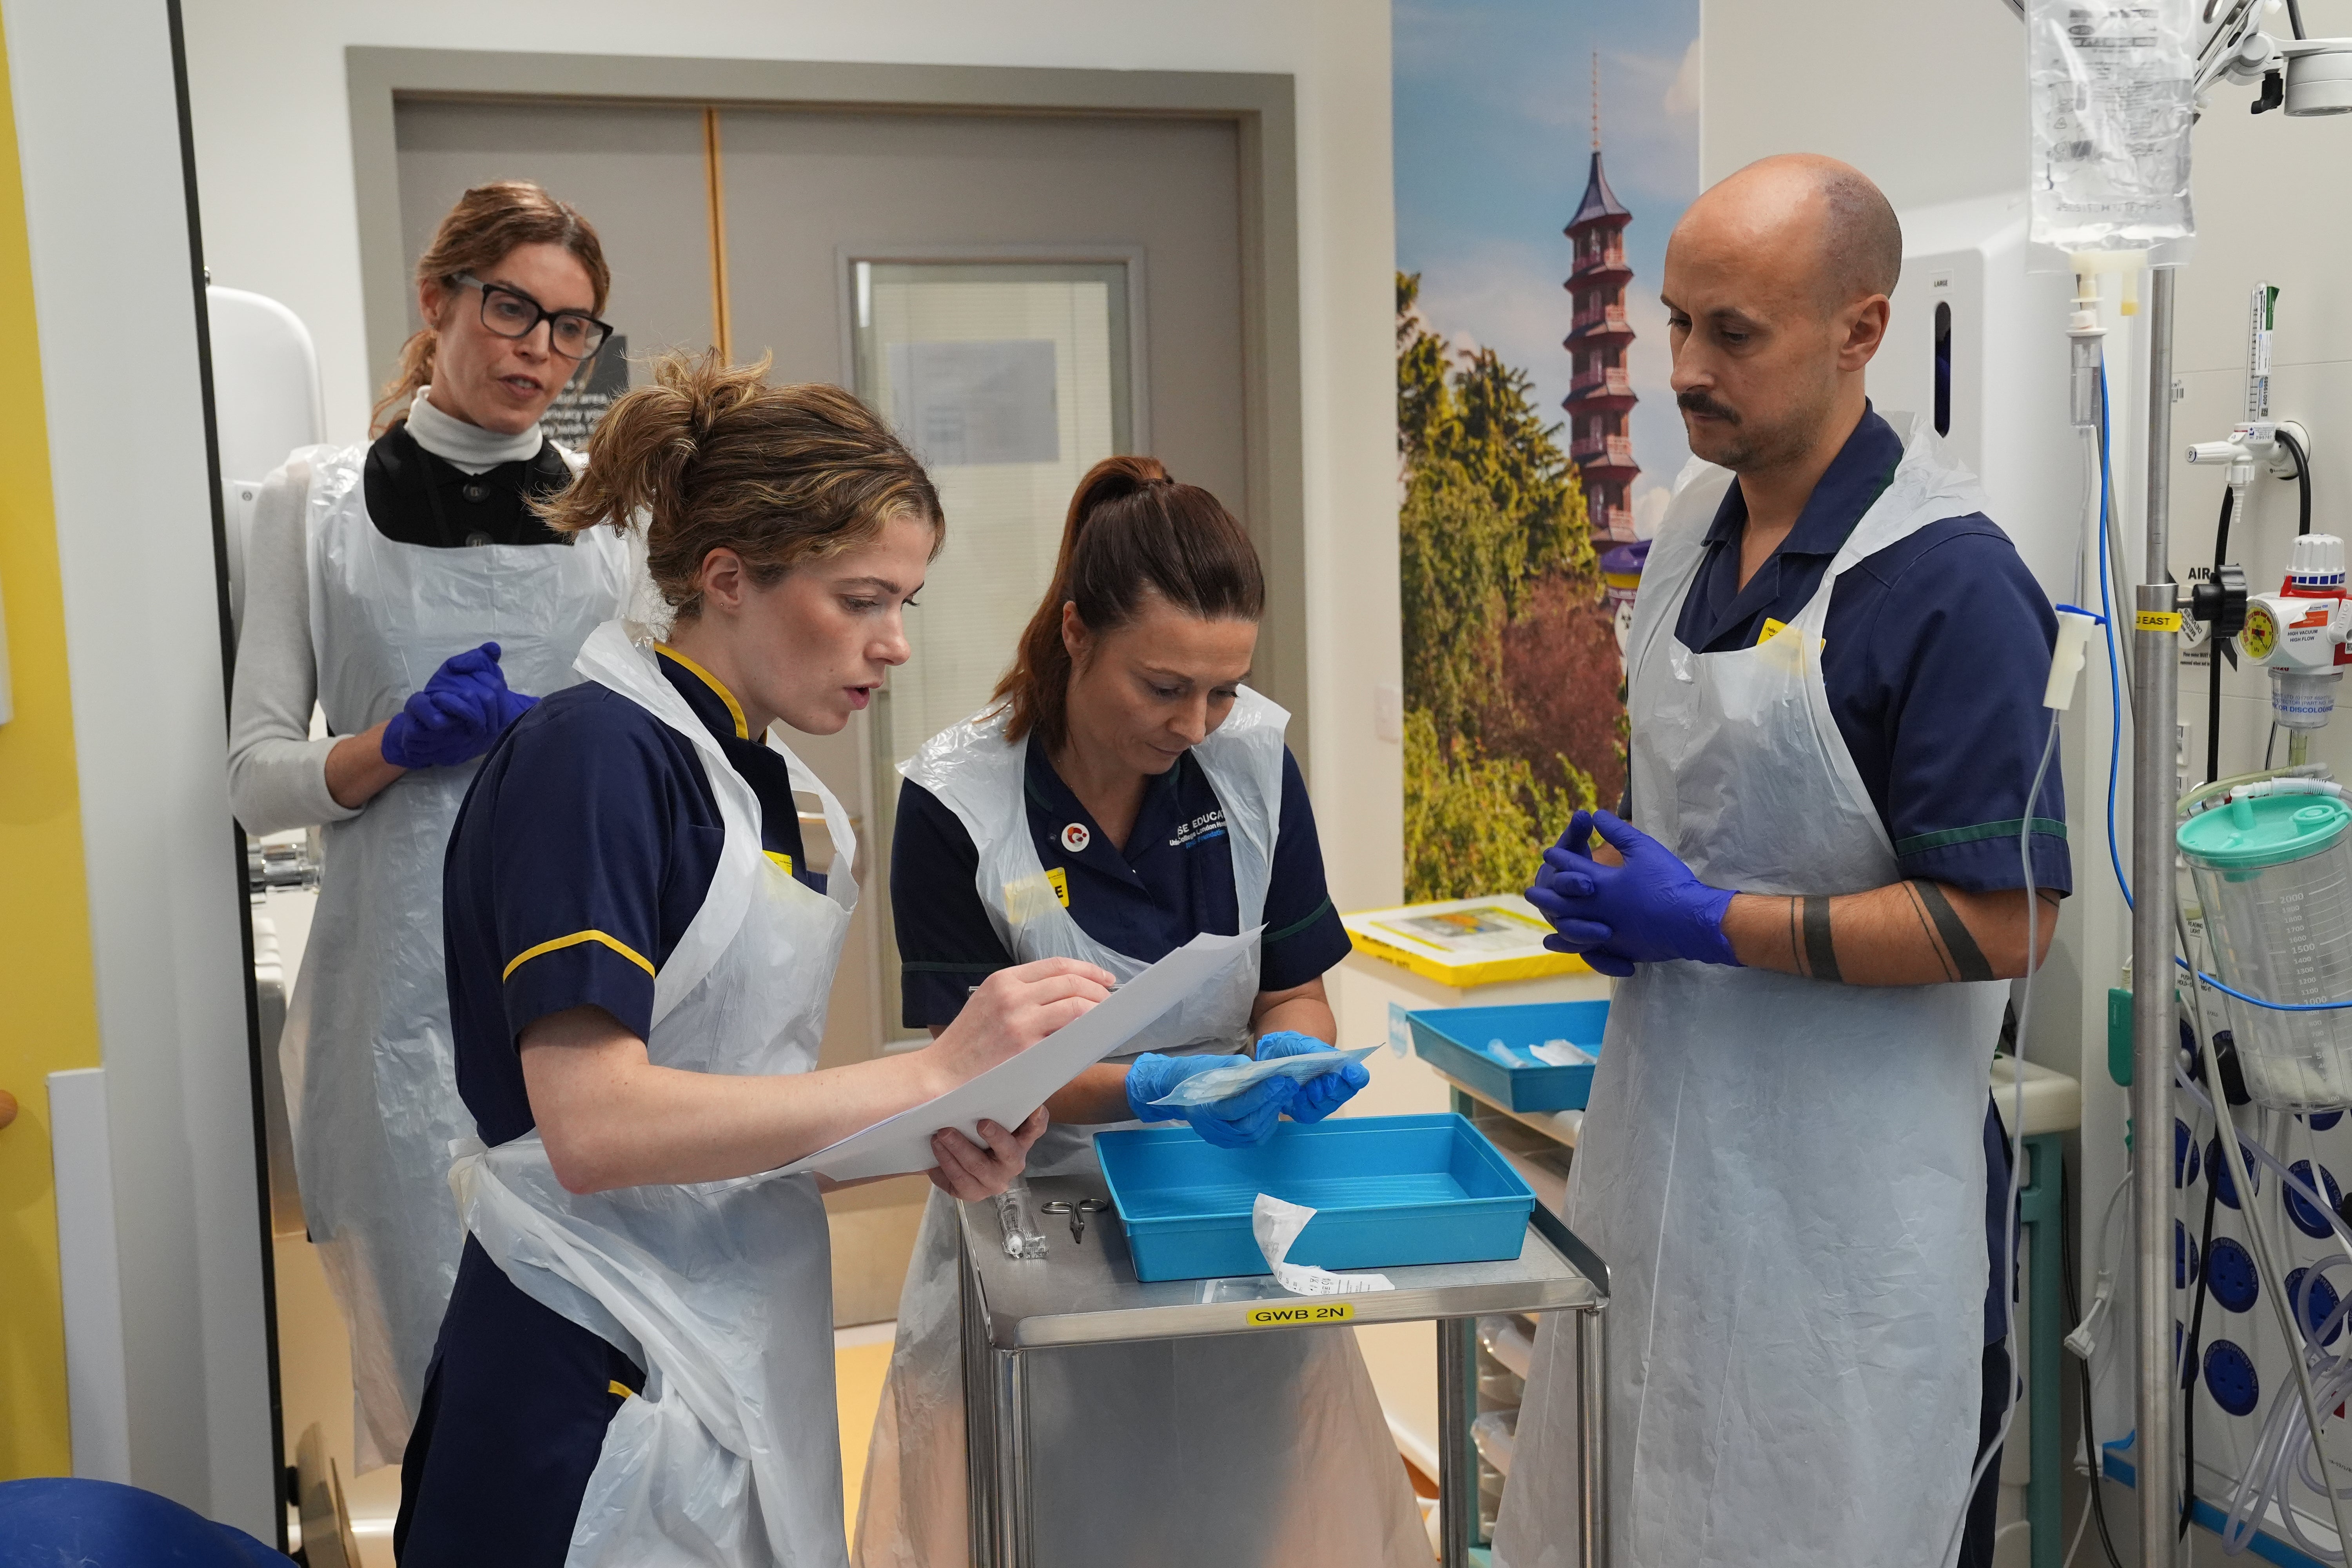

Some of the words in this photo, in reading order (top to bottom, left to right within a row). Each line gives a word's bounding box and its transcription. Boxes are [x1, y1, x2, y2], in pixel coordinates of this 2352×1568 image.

[2188, 567, 2210, 580] AIR
[2143, 616, 2170, 625] EAST
[1192, 810, 1224, 828] EDUCA
[2279, 893, 2304, 904] 2000
[2286, 925, 2304, 933] 1700
[2292, 943, 2315, 954] 1500
[1255, 1310, 1308, 1321] GWB
[1316, 1307, 1344, 1318] 2N
